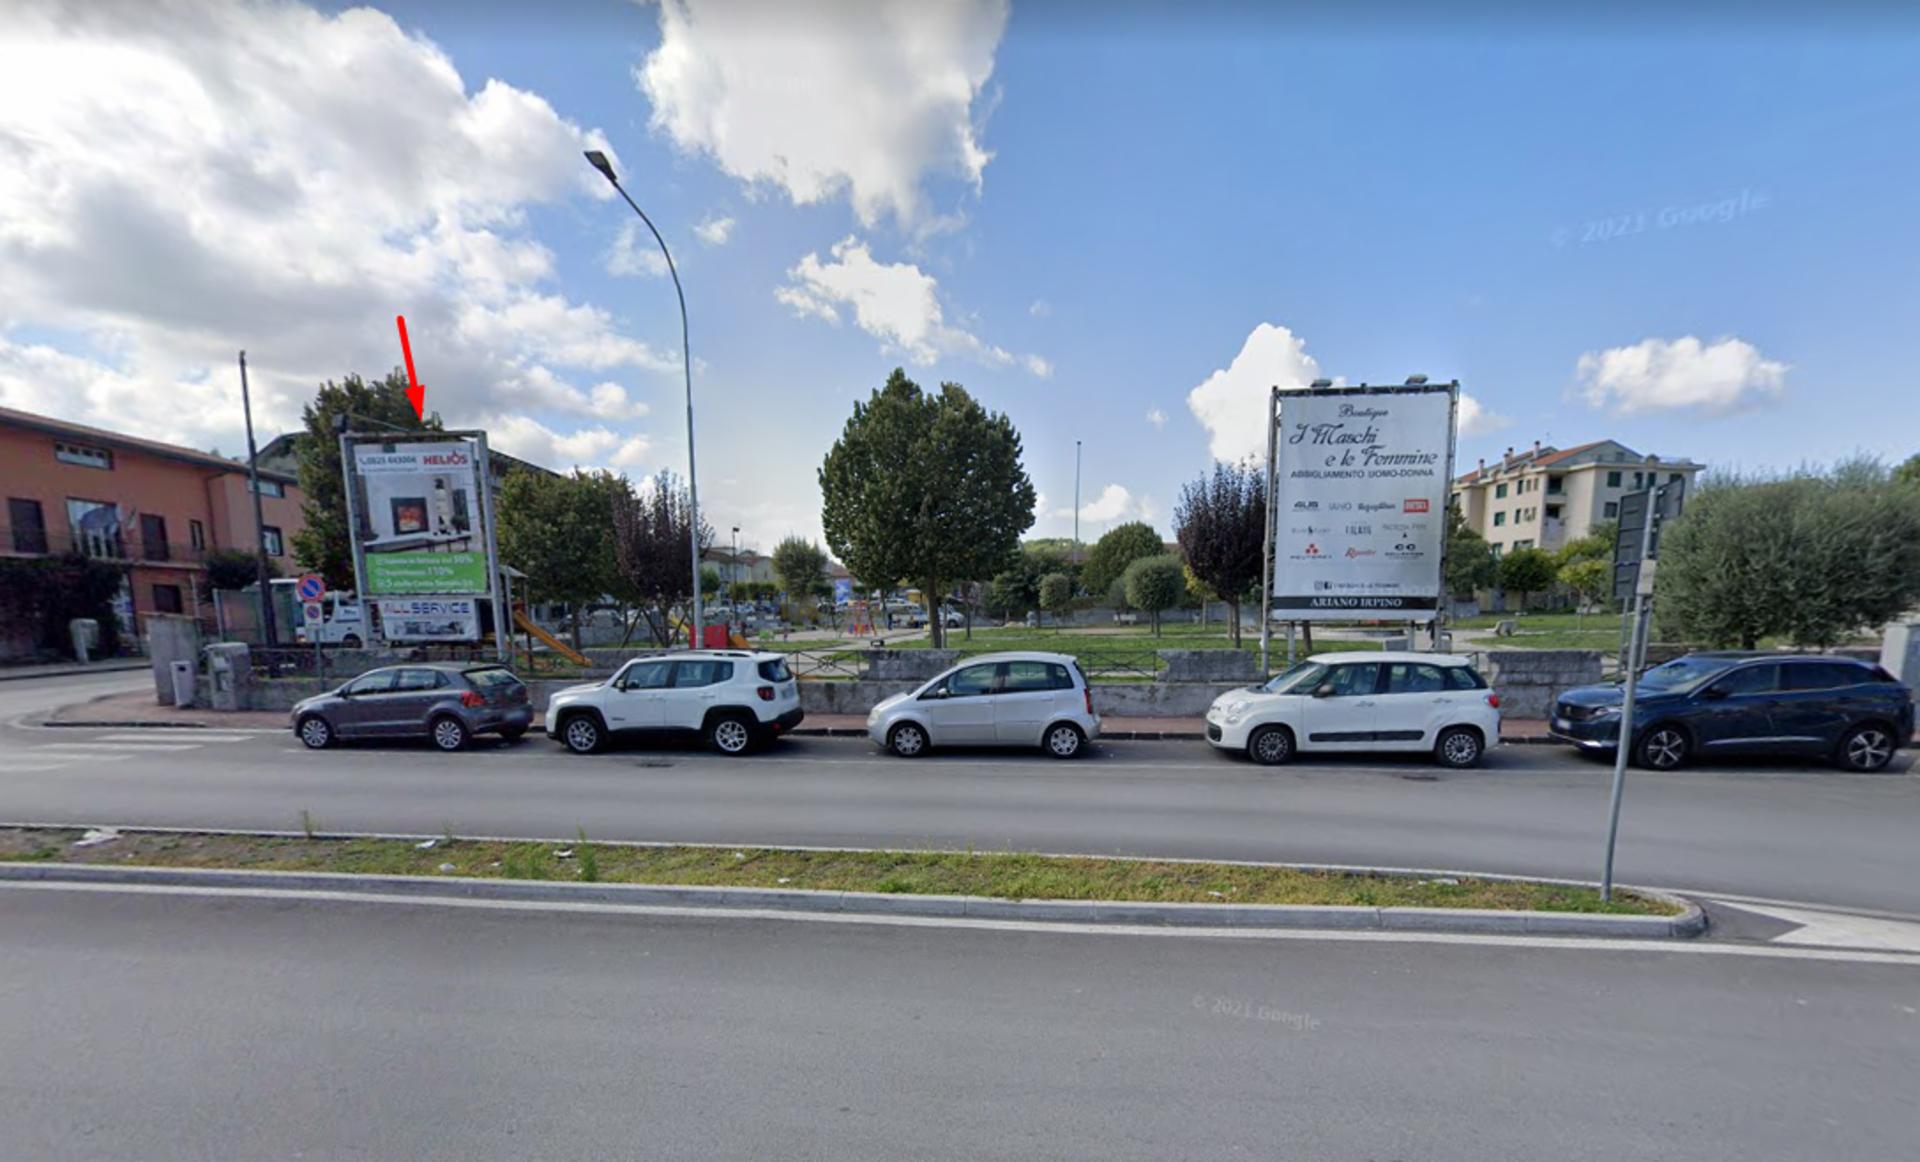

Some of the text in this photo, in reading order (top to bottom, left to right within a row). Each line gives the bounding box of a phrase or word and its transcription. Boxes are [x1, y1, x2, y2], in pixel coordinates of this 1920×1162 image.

[1312, 423, 1380, 445] Maschi
[1325, 454, 1336, 467] e
[1290, 469, 1365, 479] ABBIGLIAMENTO
[411, 602, 470, 614] SERVICE
[1310, 597, 1402, 607] ARIANO IRPINO
